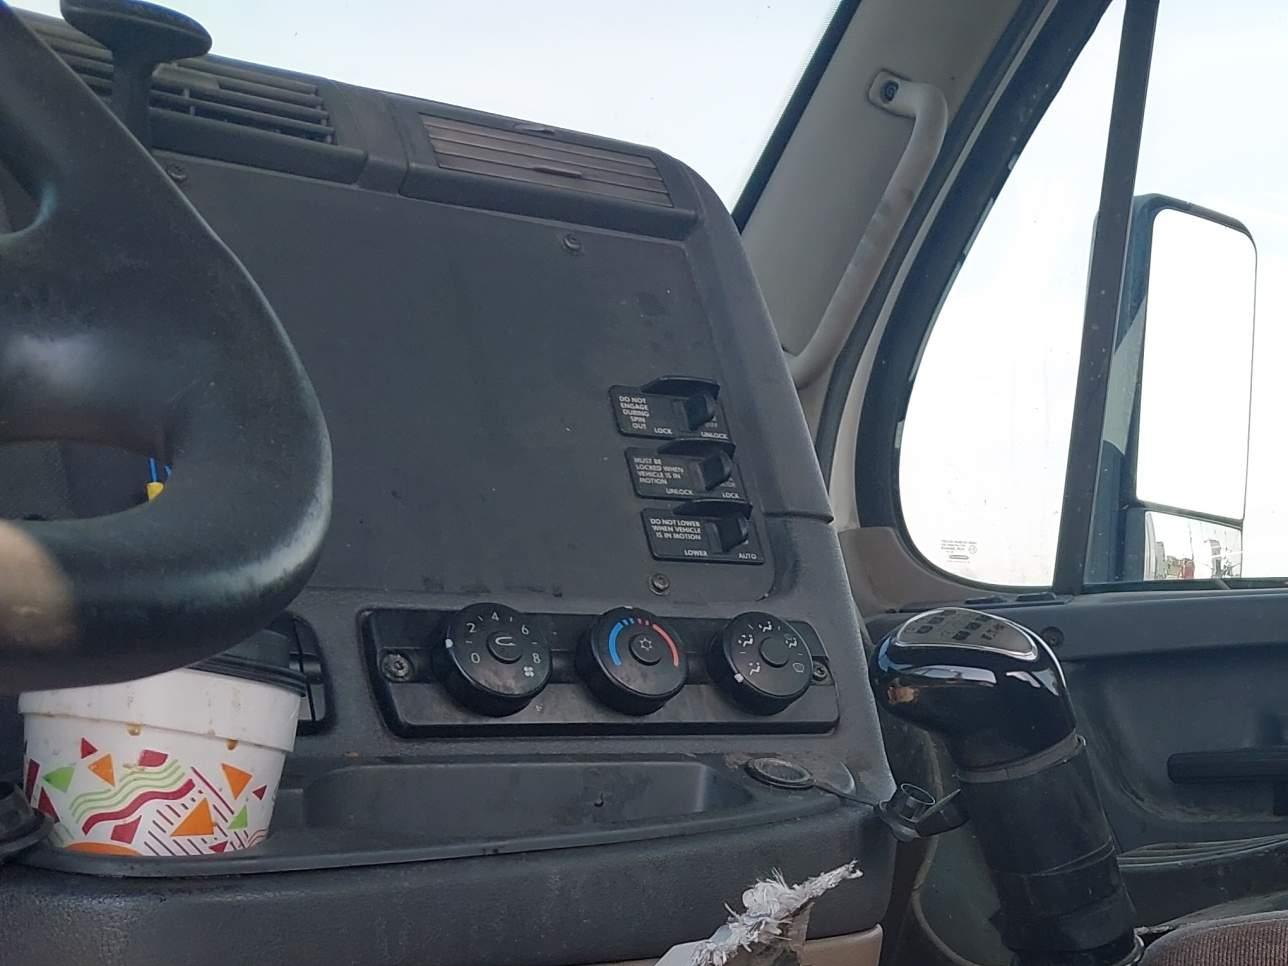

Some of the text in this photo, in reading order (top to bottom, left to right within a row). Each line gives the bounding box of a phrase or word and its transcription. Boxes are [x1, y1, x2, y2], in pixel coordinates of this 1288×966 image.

[491, 611, 500, 621] 4
[466, 623, 477, 633] 2
[521, 624, 529, 635] 6
[471, 653, 480, 663] 0
[532, 653, 540, 664] 8
